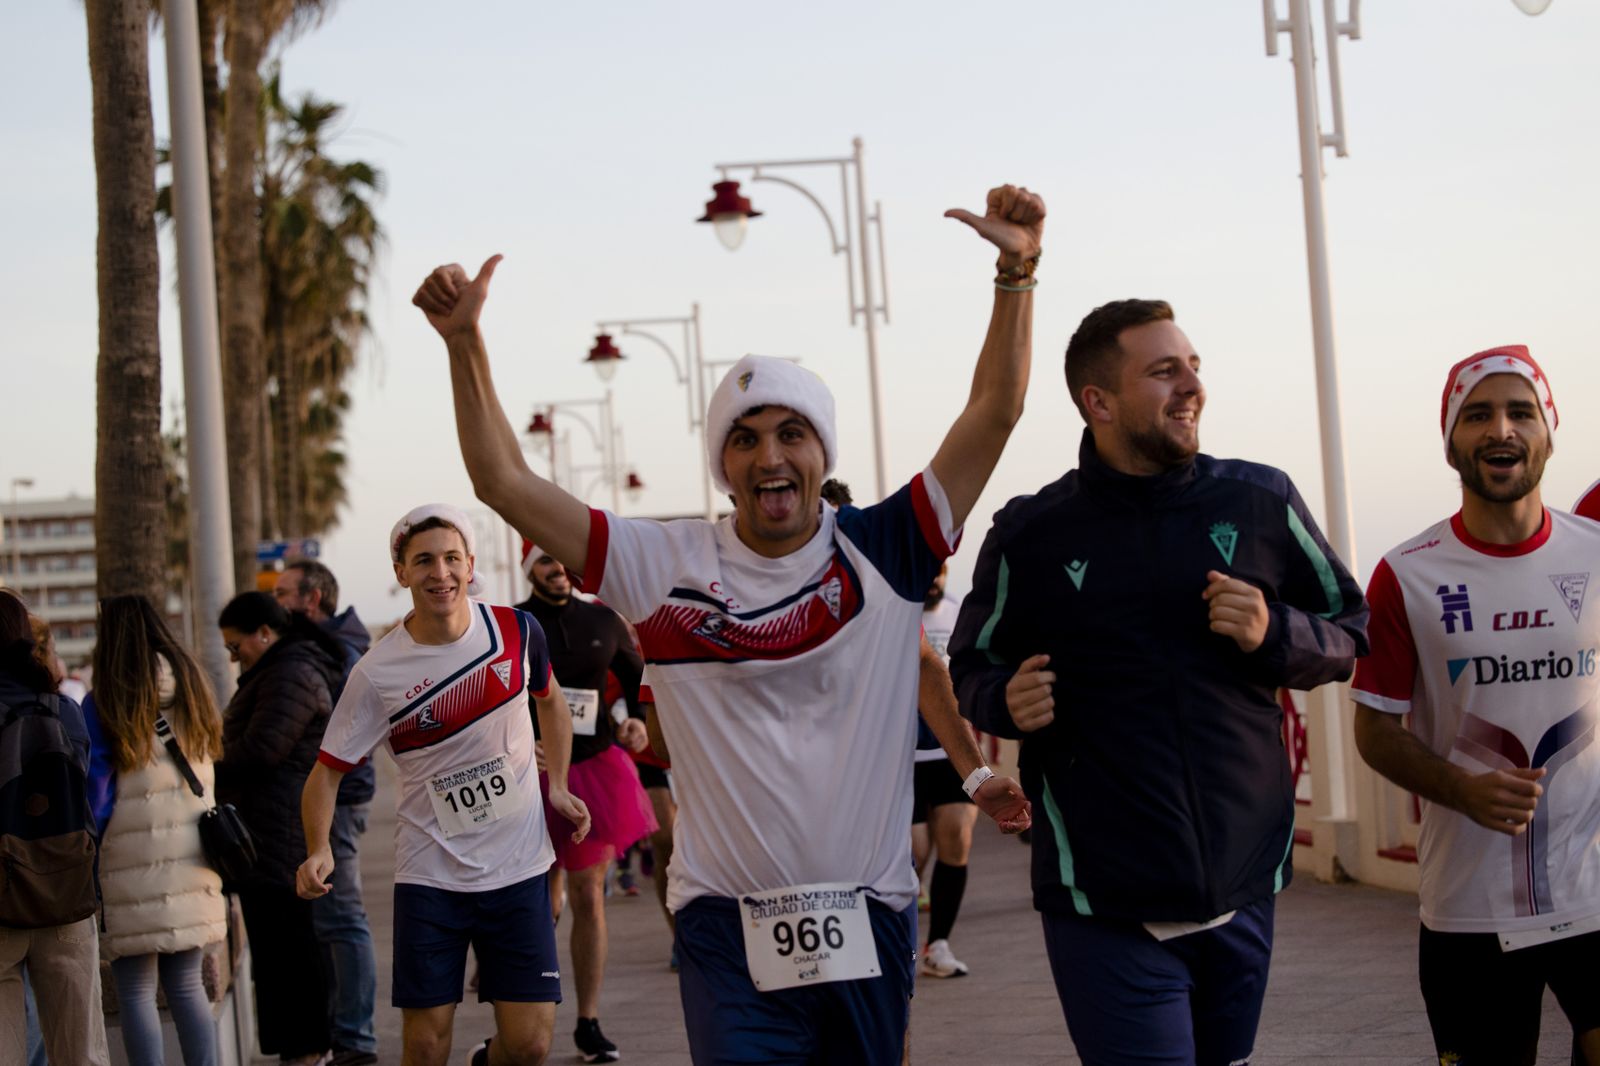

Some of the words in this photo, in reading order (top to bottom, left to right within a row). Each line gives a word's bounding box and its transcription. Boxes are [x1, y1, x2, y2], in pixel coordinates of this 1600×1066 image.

[1493, 609, 1554, 631] C.D.C.
[1472, 651, 1573, 685] Diario
[1577, 648, 1596, 677] 16
[405, 678, 434, 700] C.D.C.
[432, 776, 451, 786] SAN
[434, 778, 466, 793] CIUDAD
[467, 773, 480, 782] DE
[445, 775, 506, 813] 1019
[468, 801, 492, 814] LUCERO
[781, 890, 857, 903] SILVESTRE
[751, 903, 798, 920] CIUDAD
[802, 901, 819, 912] DE
[773, 915, 844, 957] 966
[793, 952, 831, 965] CHACAR
